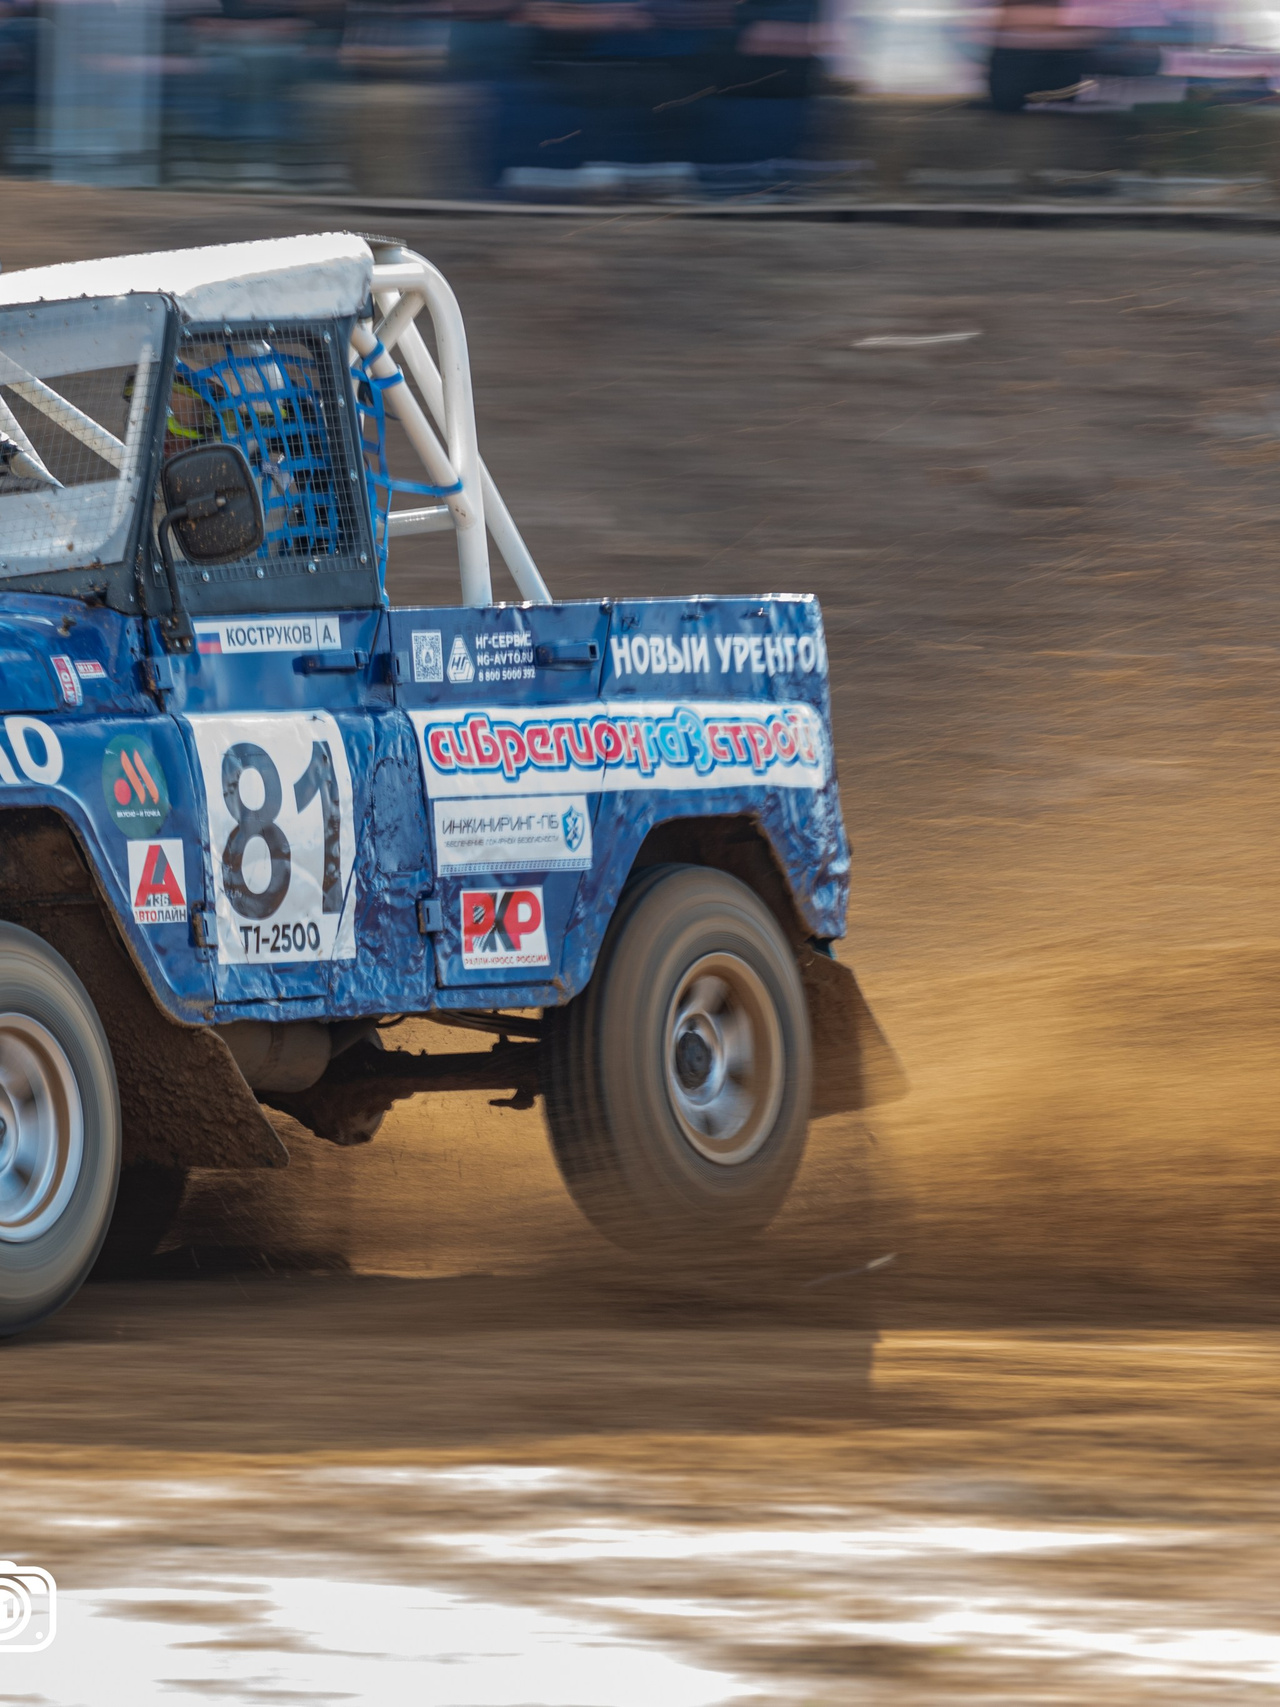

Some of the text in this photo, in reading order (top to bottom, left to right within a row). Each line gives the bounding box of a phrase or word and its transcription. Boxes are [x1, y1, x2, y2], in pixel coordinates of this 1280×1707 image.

[225, 624, 336, 647] КОСТРУКОВ А.
[475, 632, 533, 649] НГ-СЕРВИС
[477, 650, 534, 666] NG-AVTO.RU
[478, 669, 484, 682] 8
[485, 668, 500, 681] 800
[502, 667, 521, 681] 5000
[221, 741, 345, 921] 81
[442, 814, 560, 835] ИНЖИНИРИНГ-ПБ
[147, 893, 170, 907] 136
[240, 922, 321, 954] Т1-2500
